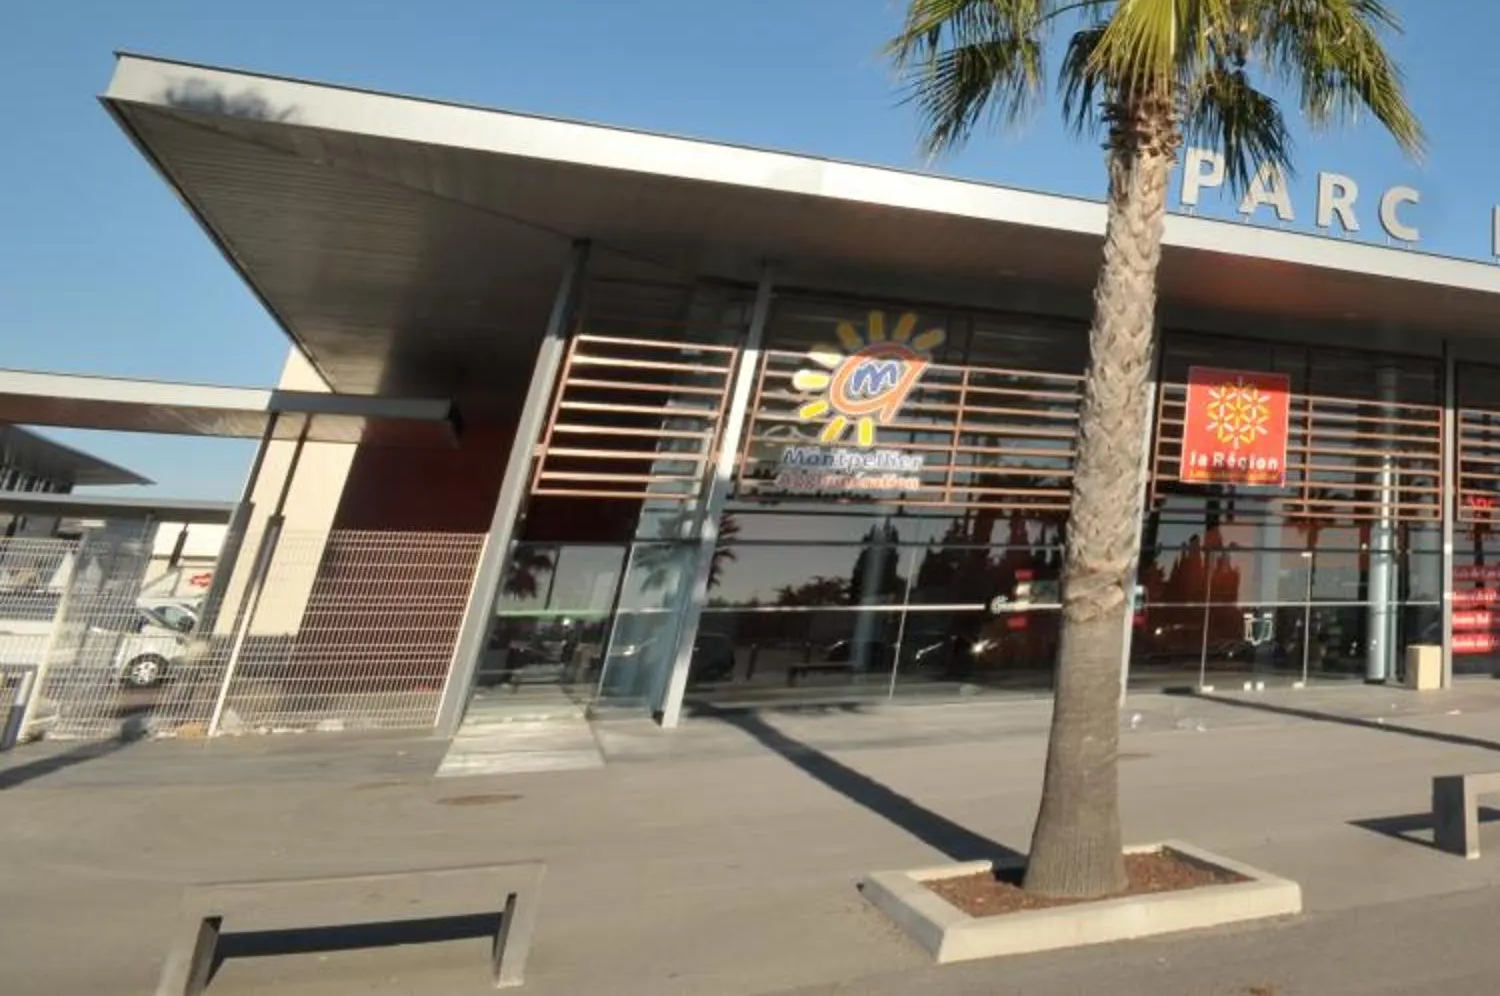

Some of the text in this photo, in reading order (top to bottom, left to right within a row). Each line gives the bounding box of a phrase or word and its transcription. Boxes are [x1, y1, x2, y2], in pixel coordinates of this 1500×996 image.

[1180, 146, 1422, 243] PARC
[1189, 451, 1279, 473] la Région
